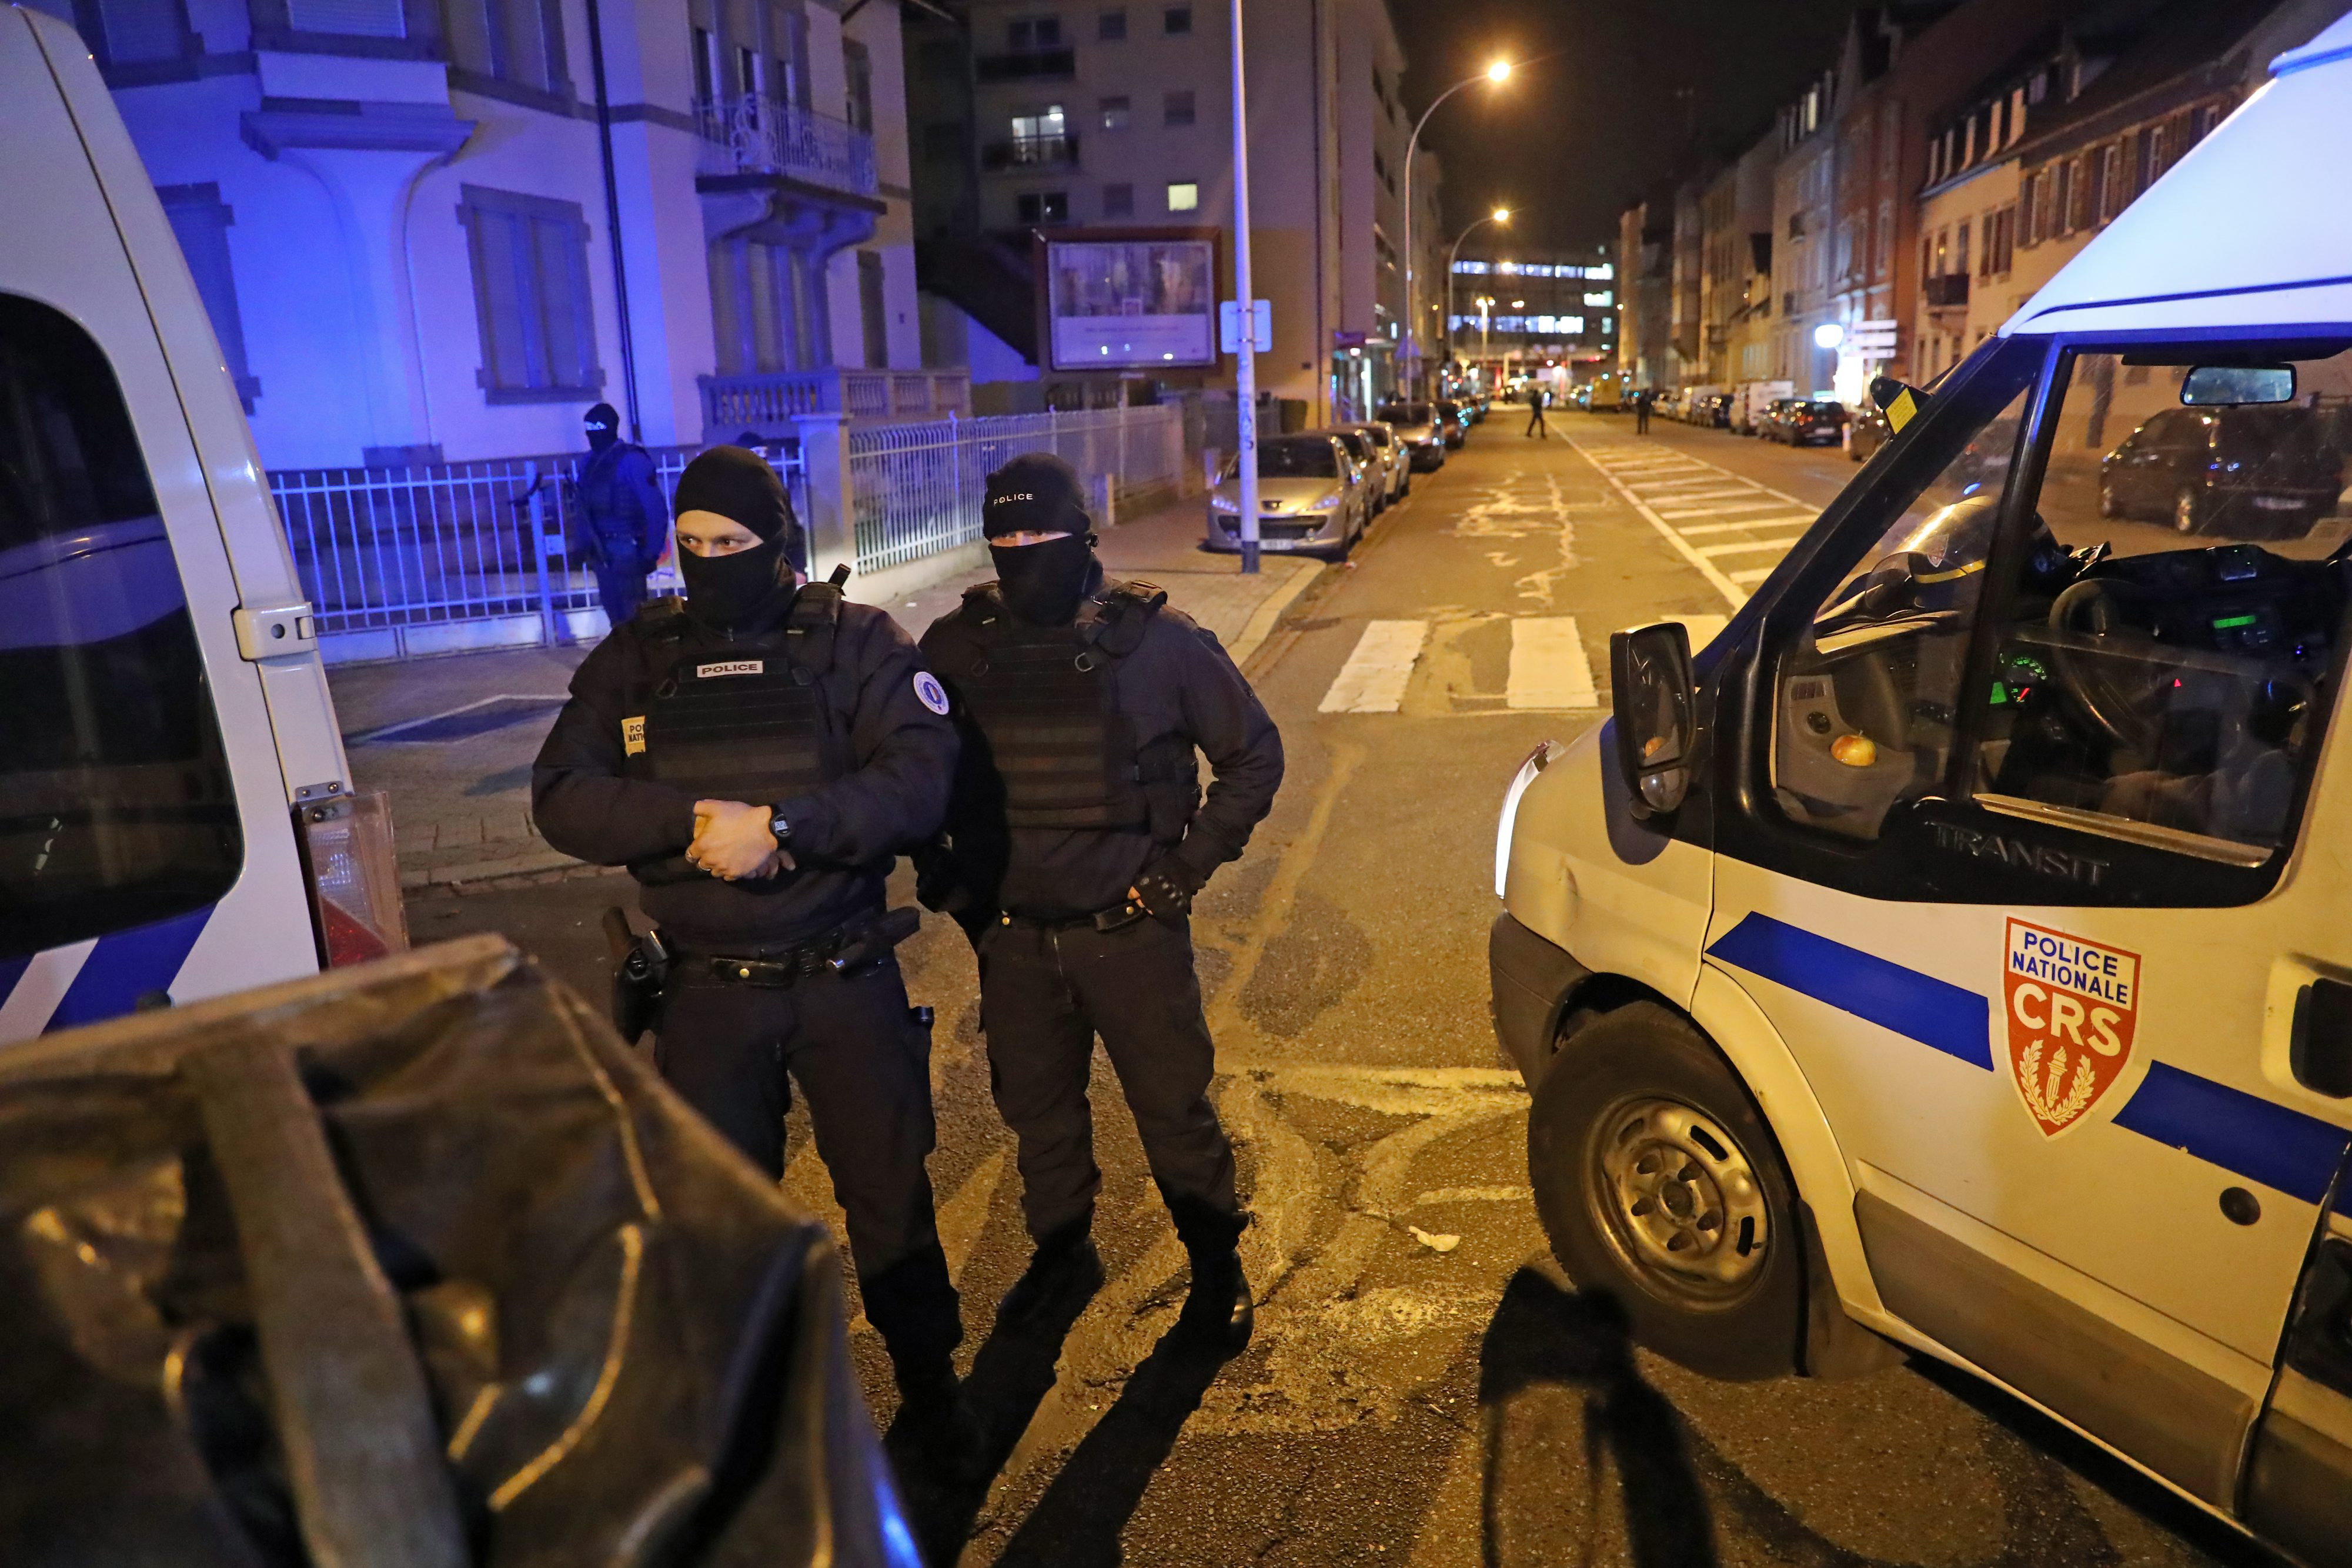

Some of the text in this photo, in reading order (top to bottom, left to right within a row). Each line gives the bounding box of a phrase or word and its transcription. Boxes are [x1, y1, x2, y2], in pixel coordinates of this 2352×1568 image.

[993, 493, 1033, 506] POLICE
[701, 664, 758, 675] POLICE
[629, 733, 644, 742] NATI
[1924, 821, 2111, 886] TRANSIT
[2024, 931, 2118, 977] POLICE
[2013, 951, 2128, 1005] NATIONALE
[2013, 982, 2122, 1057] CRS
